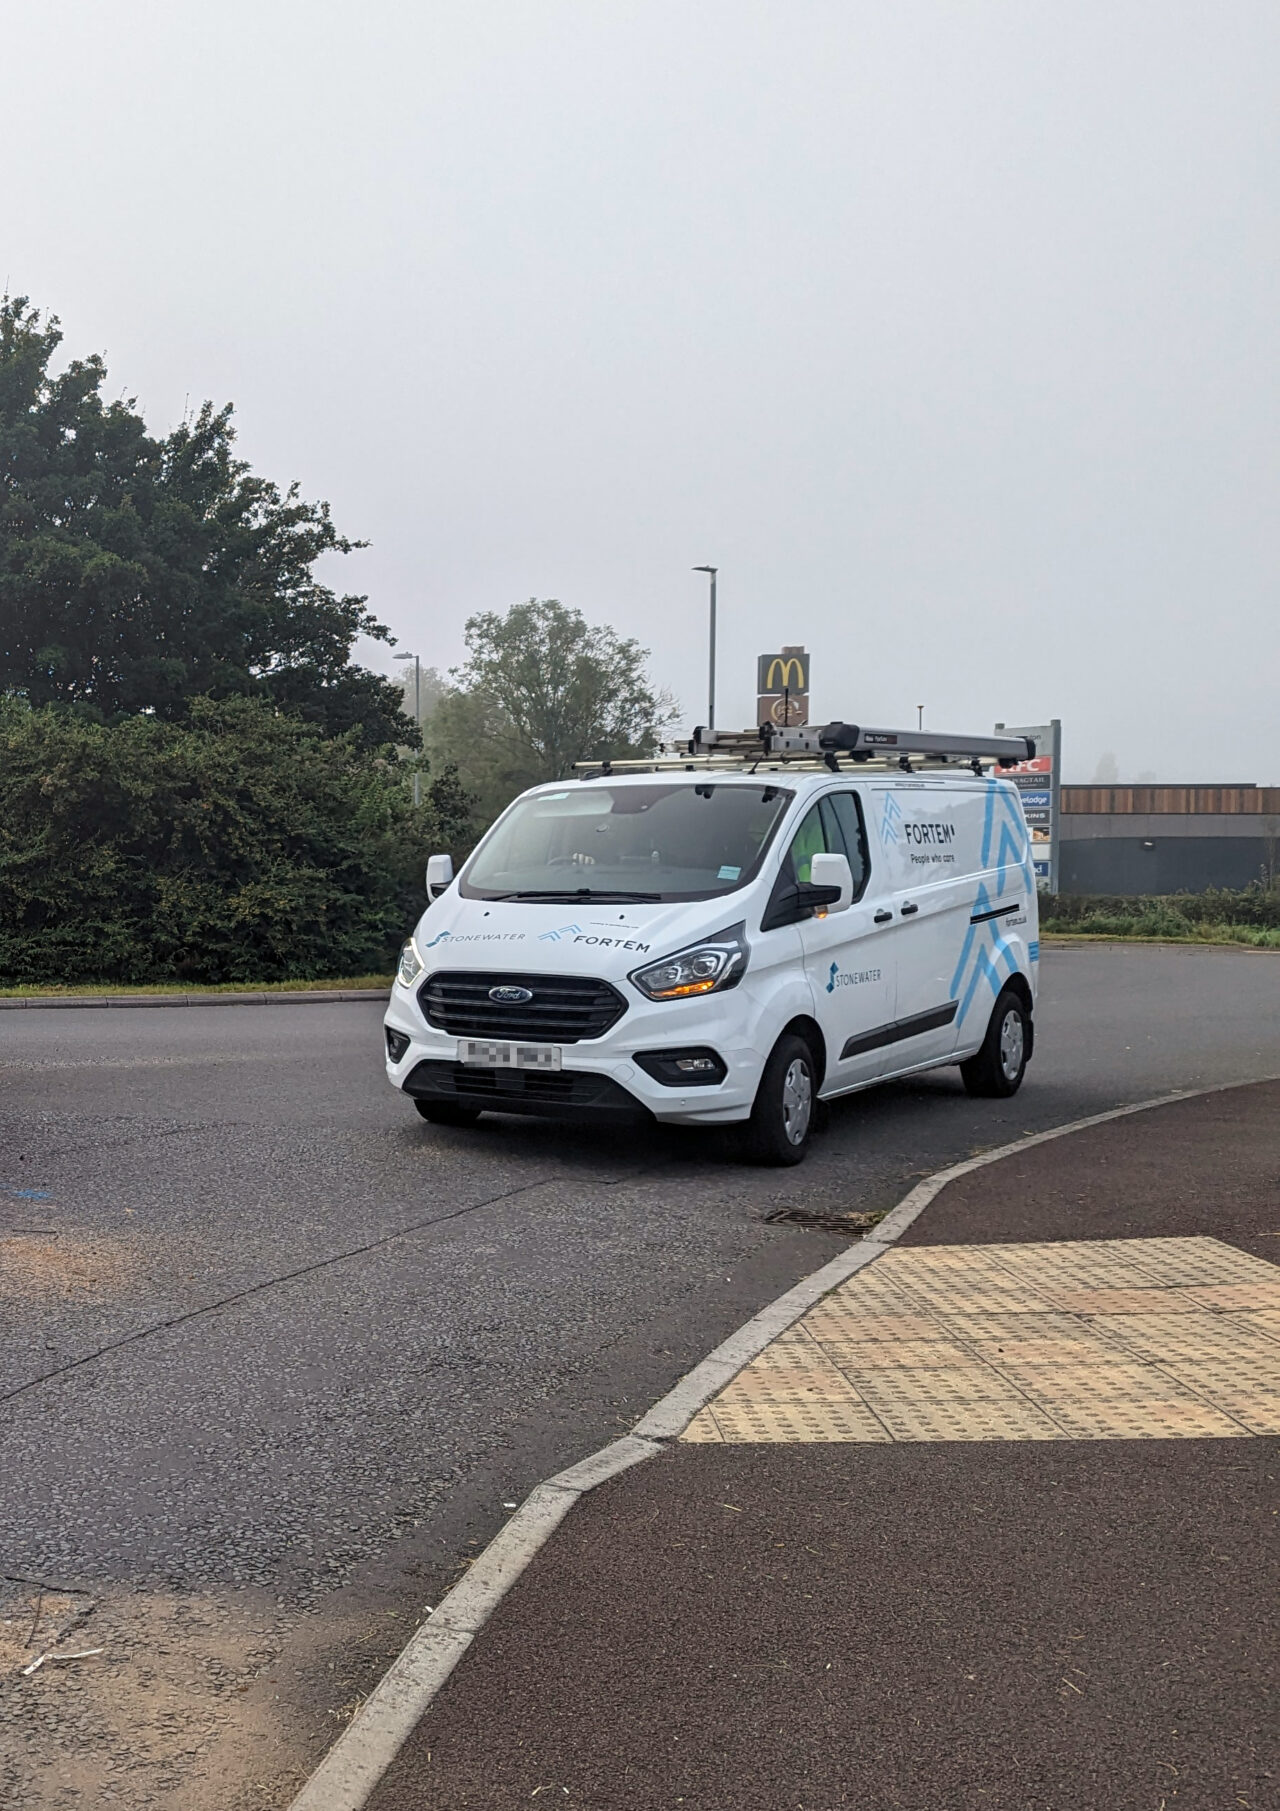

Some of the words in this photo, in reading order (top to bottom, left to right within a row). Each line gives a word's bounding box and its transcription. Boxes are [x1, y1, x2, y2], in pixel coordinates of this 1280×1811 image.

[910, 853, 930, 866] People
[931, 853, 942, 863] who
[943, 854, 955, 863] care
[441, 933, 526, 943] STONEWATER
[573, 935, 651, 953] FORTEM
[836, 969, 882, 987] STONEWATER
[495, 988, 521, 1000] Ford
